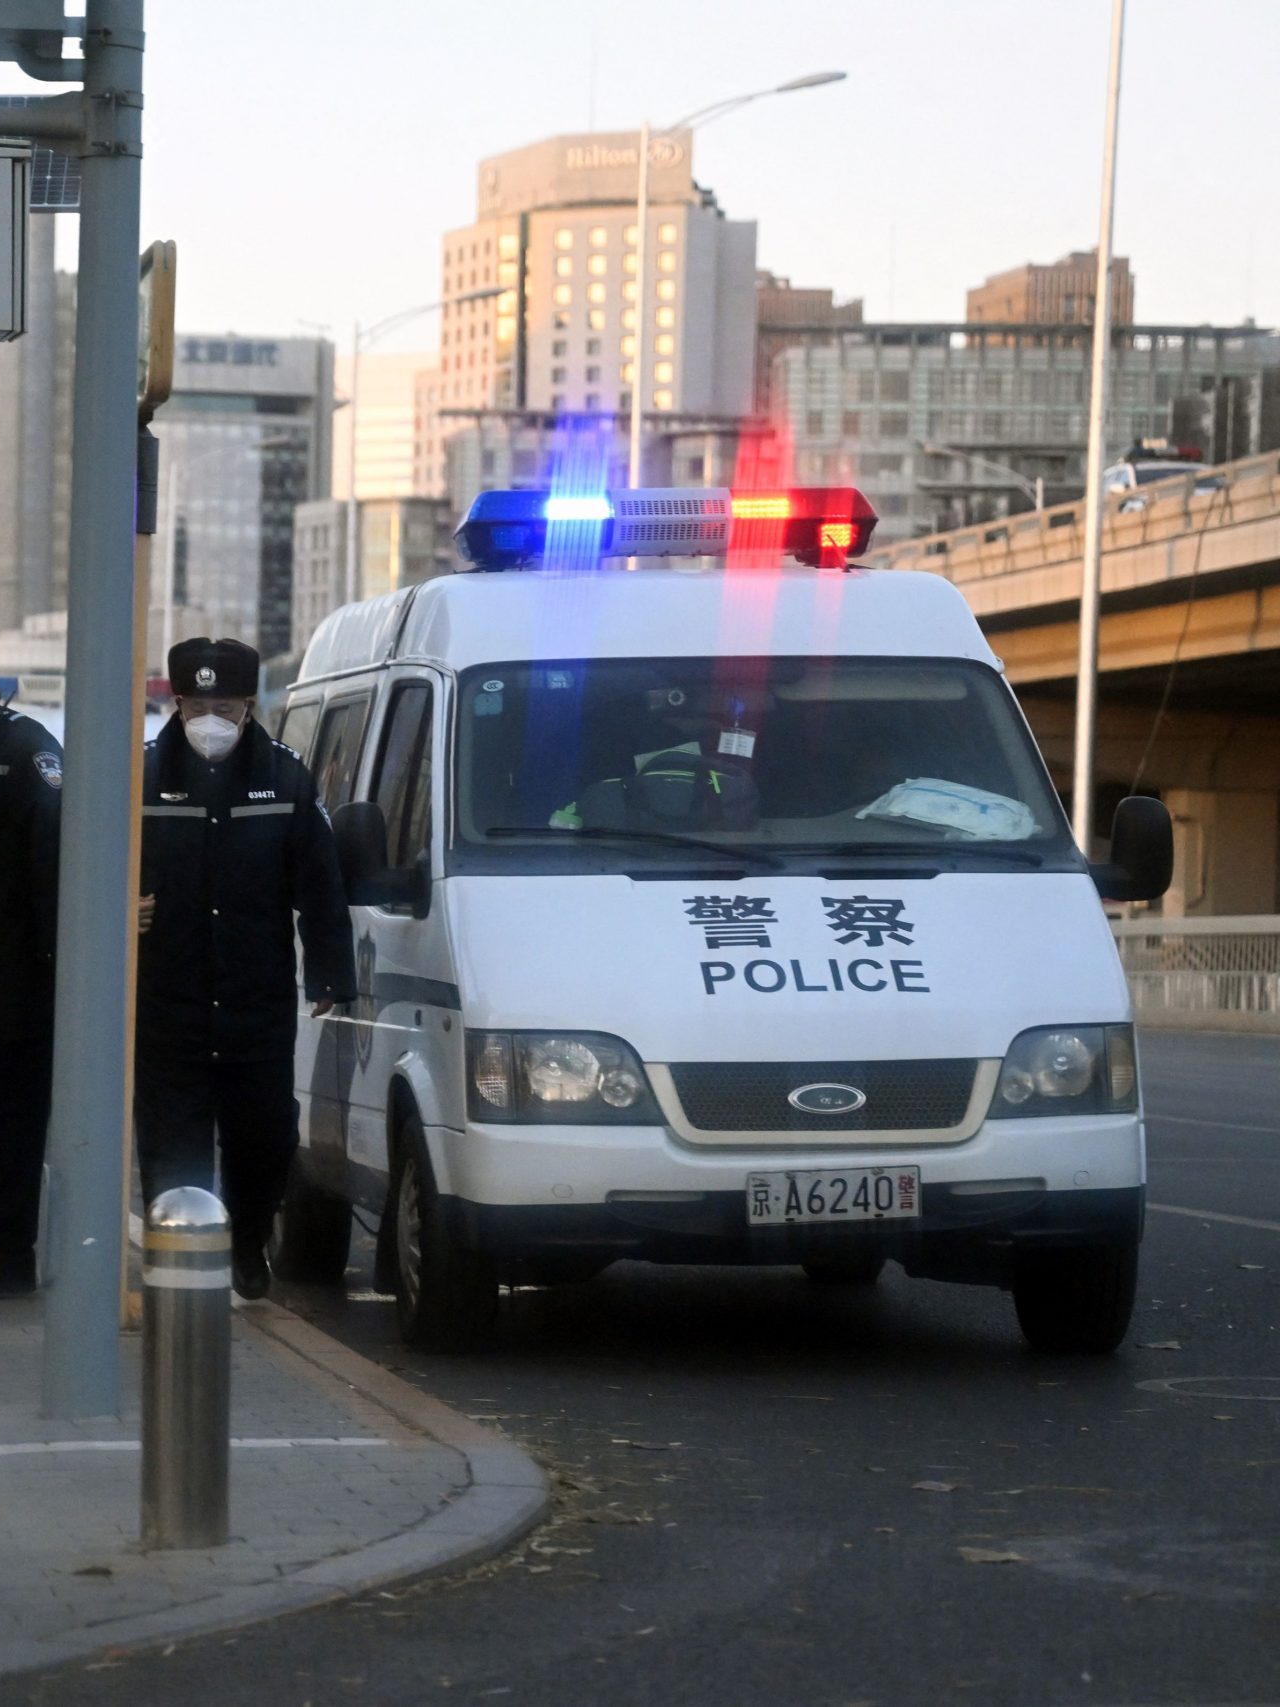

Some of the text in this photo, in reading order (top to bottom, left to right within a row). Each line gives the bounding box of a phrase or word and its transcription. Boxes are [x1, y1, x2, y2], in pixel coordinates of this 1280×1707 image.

[566, 144, 638, 169] Hilton
[683, 895, 915, 949] 警察
[700, 959, 931, 995] POLICE
